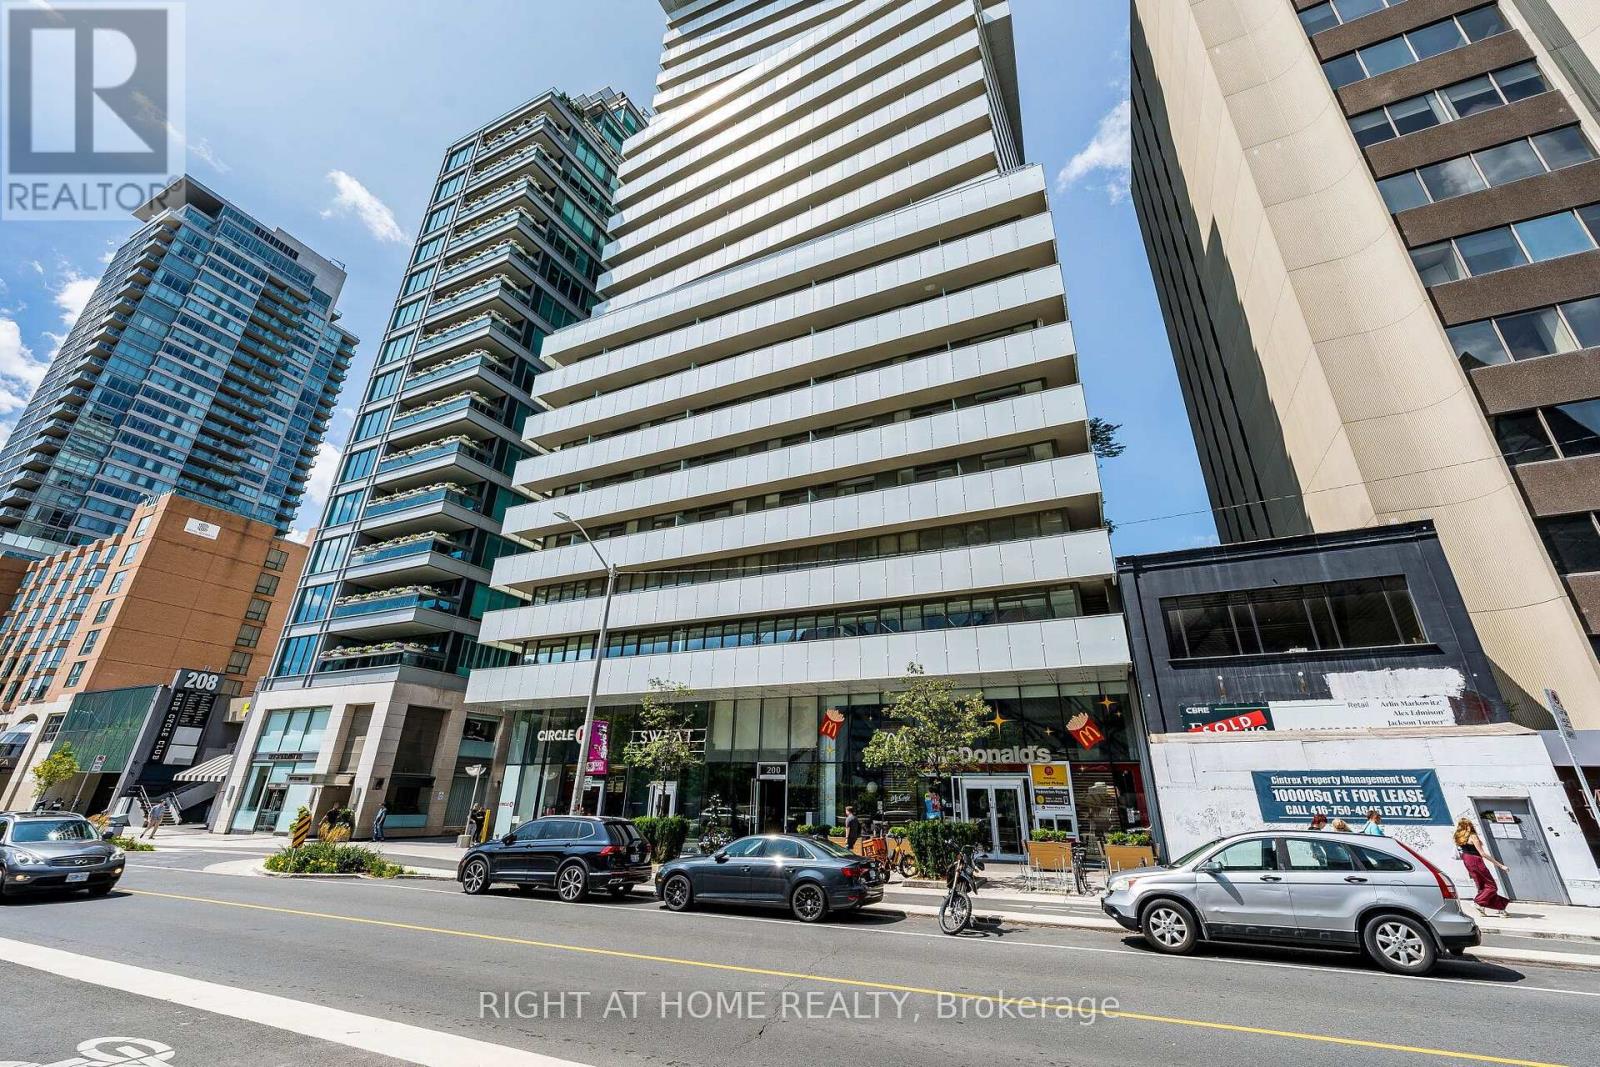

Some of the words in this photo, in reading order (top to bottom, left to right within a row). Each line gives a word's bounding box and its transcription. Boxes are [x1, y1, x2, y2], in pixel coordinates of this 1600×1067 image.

[183, 671, 219, 691] 208
[171, 692, 184, 711] RIDE
[1347, 701, 1370, 709] Retail
[1185, 706, 1210, 714] CBRE
[161, 713, 176, 737] CYCLE
[537, 729, 575, 742] CIRCLE
[151, 740, 166, 760] CLUB
[766, 766, 781, 774] 200
[1270, 775, 1302, 785] Cintrex
[1303, 775, 1341, 787] Property
[1342, 775, 1401, 786] Management
[1402, 775, 1418, 784] Inc
[1272, 788, 1332, 805] 10000Sq
[1334, 789, 1351, 803] Ft
[1351, 789, 1380, 803] FOR
[1381, 788, 1427, 803] LEASE
[1285, 805, 1310, 815] CALL
[1383, 805, 1404, 816] EXT
[1403, 804, 1431, 818] 228
